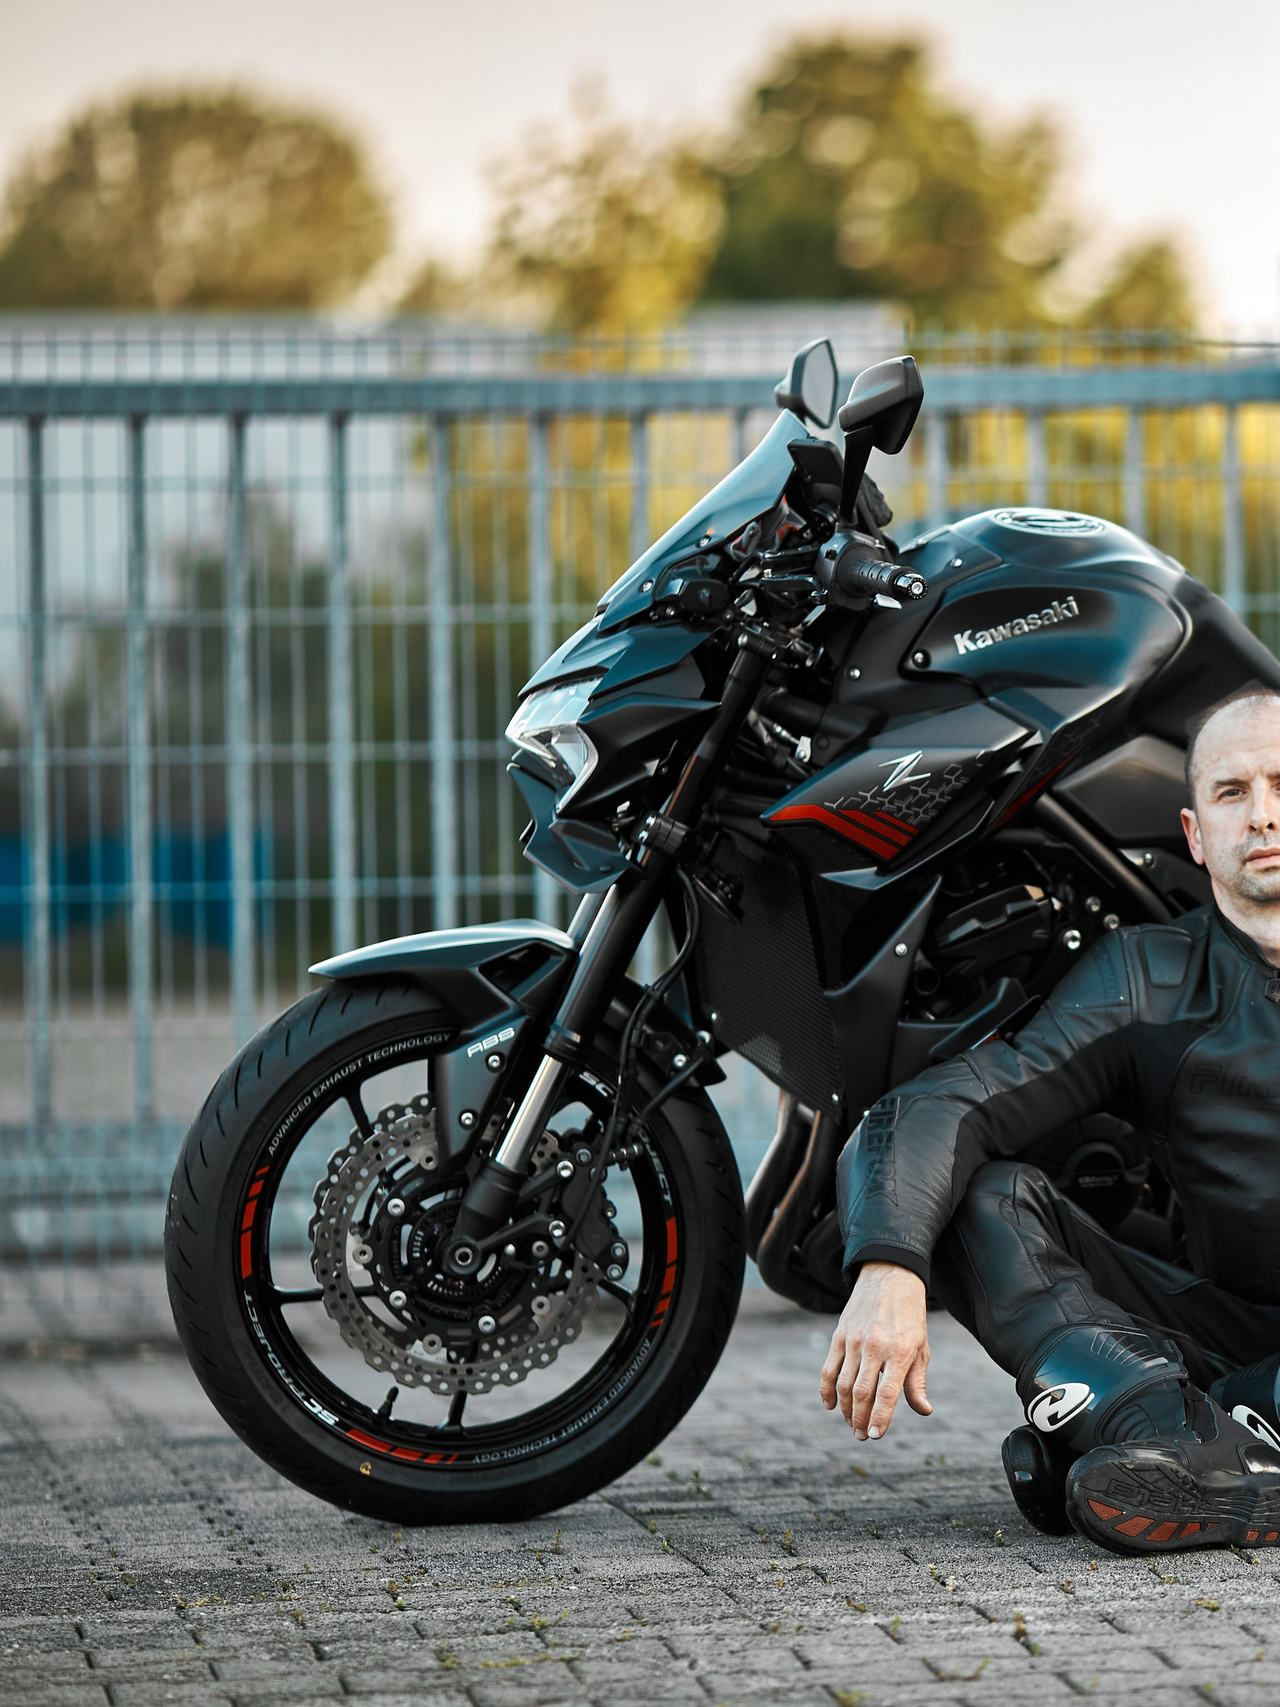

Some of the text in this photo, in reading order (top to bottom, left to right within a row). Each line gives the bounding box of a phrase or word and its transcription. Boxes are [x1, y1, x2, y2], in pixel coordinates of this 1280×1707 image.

[953, 595, 1079, 655] Kawasaki
[878, 750, 931, 792] Z
[466, 1027, 515, 1058] ABS
[268, 1033, 451, 1156] ADVANCED EXHAUST TECHNOLOGY
[579, 1071, 614, 1097] SC
[243, 1289, 306, 1402] PROJECT
[303, 1398, 340, 1426] SC
[472, 1338, 650, 1464] ADVANCED EXHAUST TECHNOLOGY
